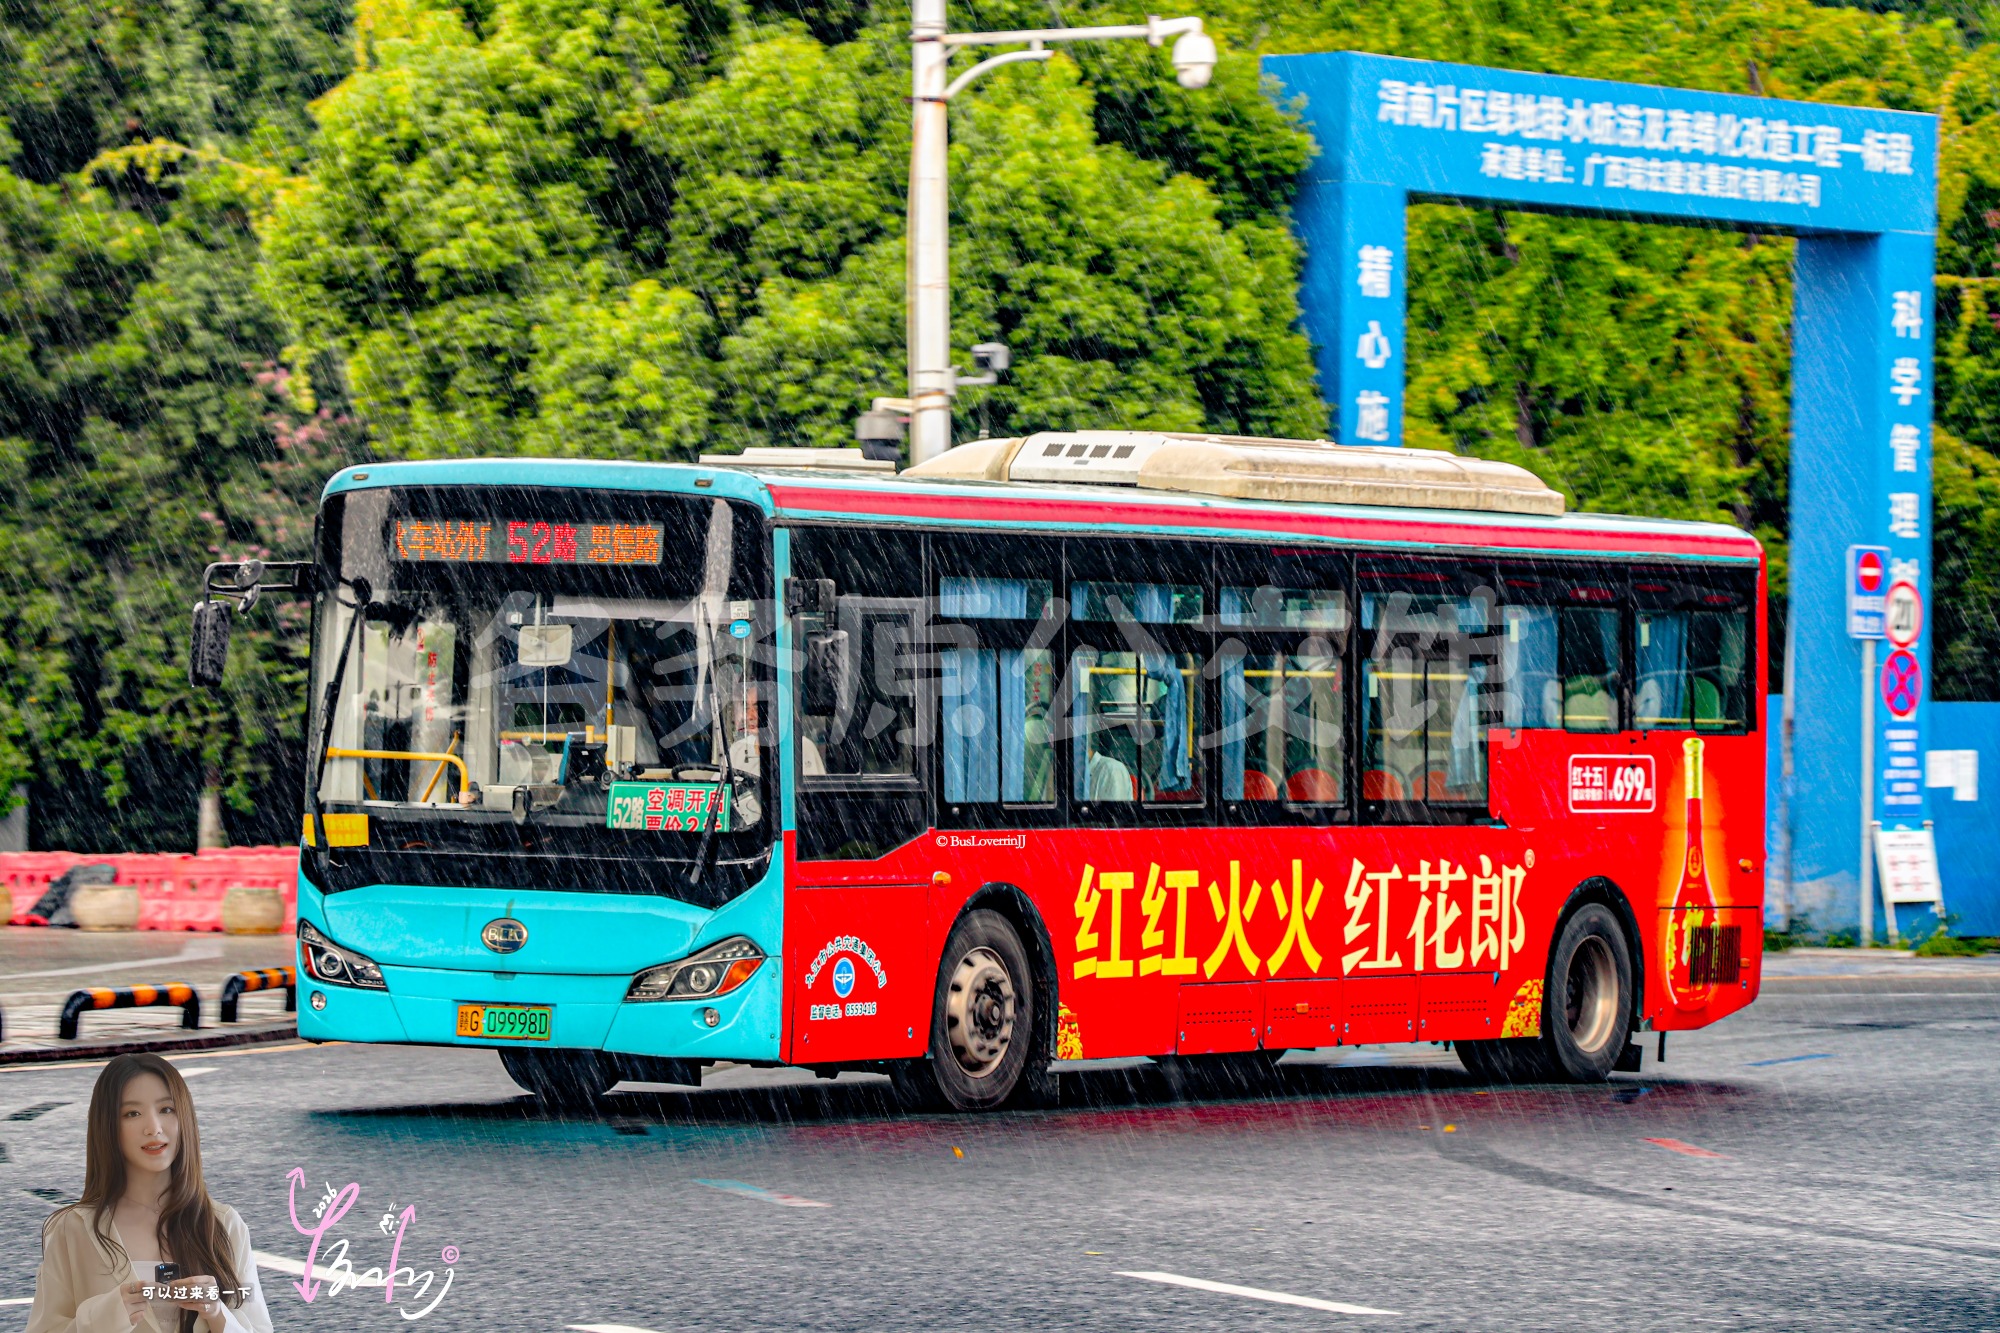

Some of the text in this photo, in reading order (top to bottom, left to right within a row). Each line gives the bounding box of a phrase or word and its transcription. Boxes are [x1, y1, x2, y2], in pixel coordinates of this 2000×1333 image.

[507, 521, 578, 564] 52路
[1572, 766, 1603, 787] 红十五
[613, 796, 644, 830] 52路
[1073, 854, 1527, 980] 红红火火 红花郎
